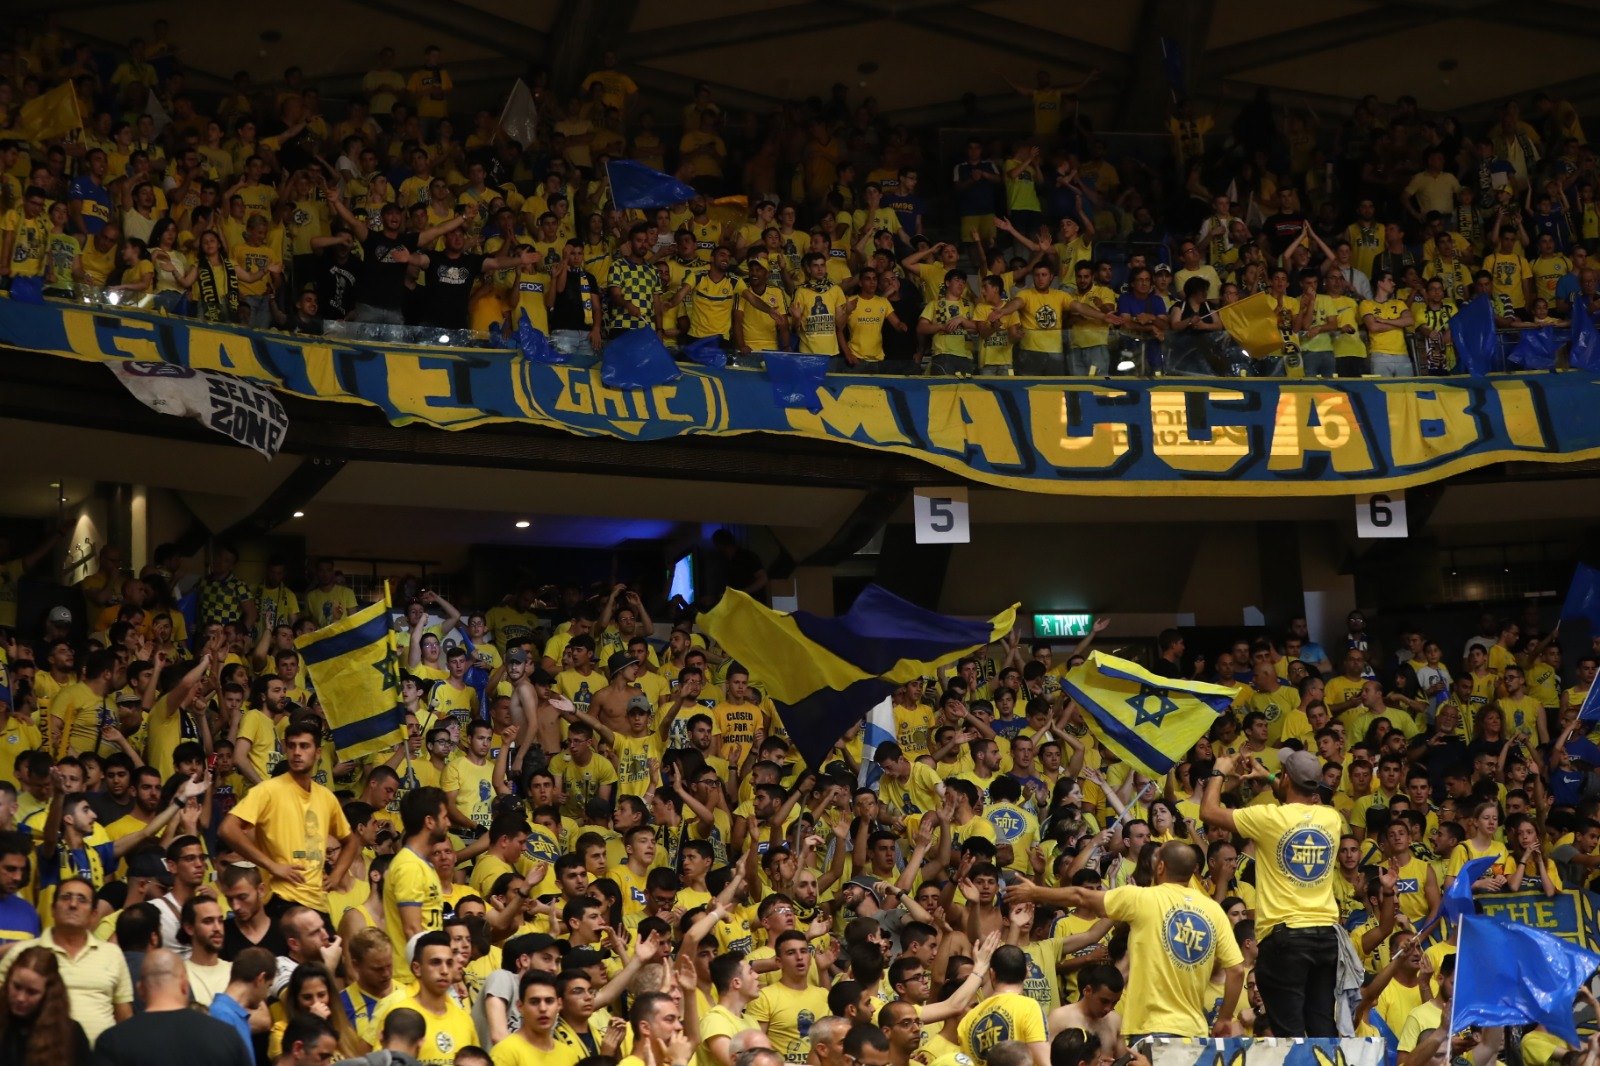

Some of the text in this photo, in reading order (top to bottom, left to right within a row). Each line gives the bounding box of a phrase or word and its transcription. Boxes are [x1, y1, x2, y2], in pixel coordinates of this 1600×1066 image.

[519, 282, 543, 292] FOX
[62, 309, 490, 421] GATE
[785, 380, 1546, 472] MACCABI
[209, 377, 288, 428] SELFIE
[210, 396, 281, 456] ZONE
[929, 497, 954, 533] 5
[1370, 494, 1392, 527] 6
[1055, 614, 1089, 636] יציאה
[727, 712, 753, 721] CLOSED
[733, 723, 748, 732] FOR
[994, 816, 1019, 830] GATE
[1291, 844, 1329, 865] GATE
[1396, 881, 1416, 892] OX
